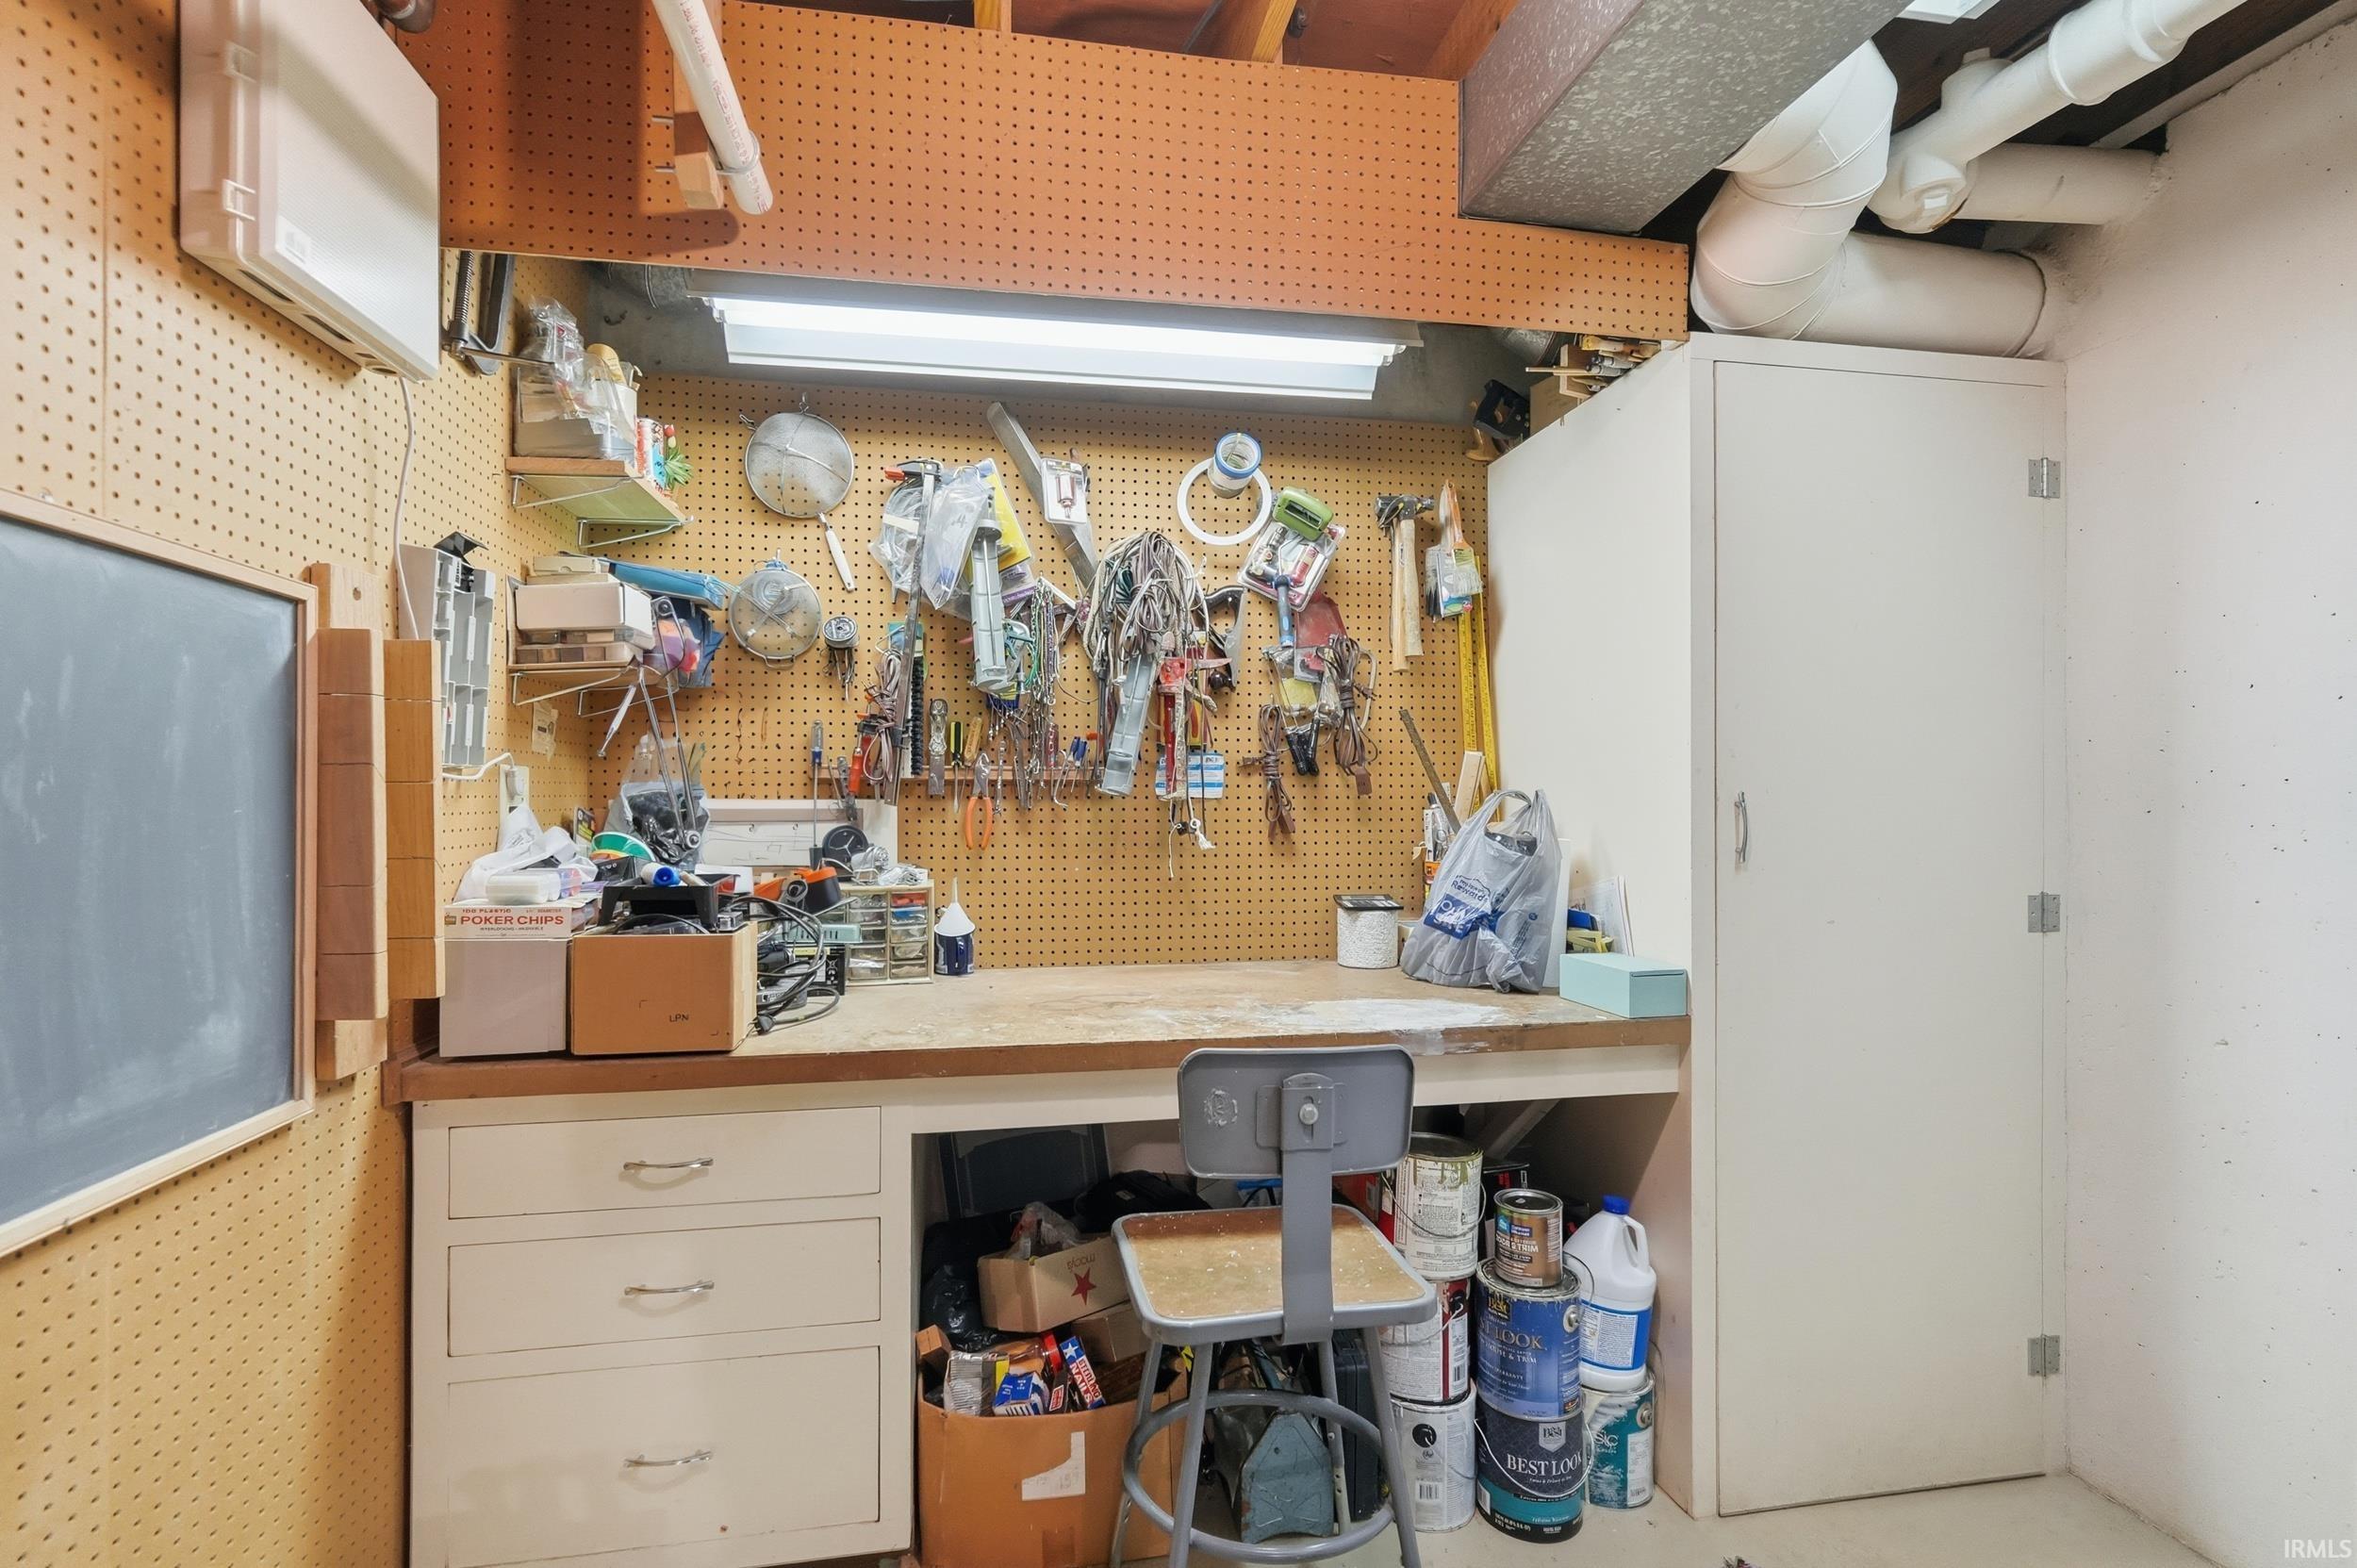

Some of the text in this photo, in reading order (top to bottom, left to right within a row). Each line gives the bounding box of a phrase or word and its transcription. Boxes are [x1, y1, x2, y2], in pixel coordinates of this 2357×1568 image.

[460, 916, 564, 925] POKER CHIPS
[1517, 1244, 1539, 1253] TRIM
[1495, 1327, 1543, 1350] LOOK
[1070, 1362, 1094, 1404] NAILS
[1507, 1453, 1549, 1476] BEST
[1552, 1448, 1583, 1476] LOOK
